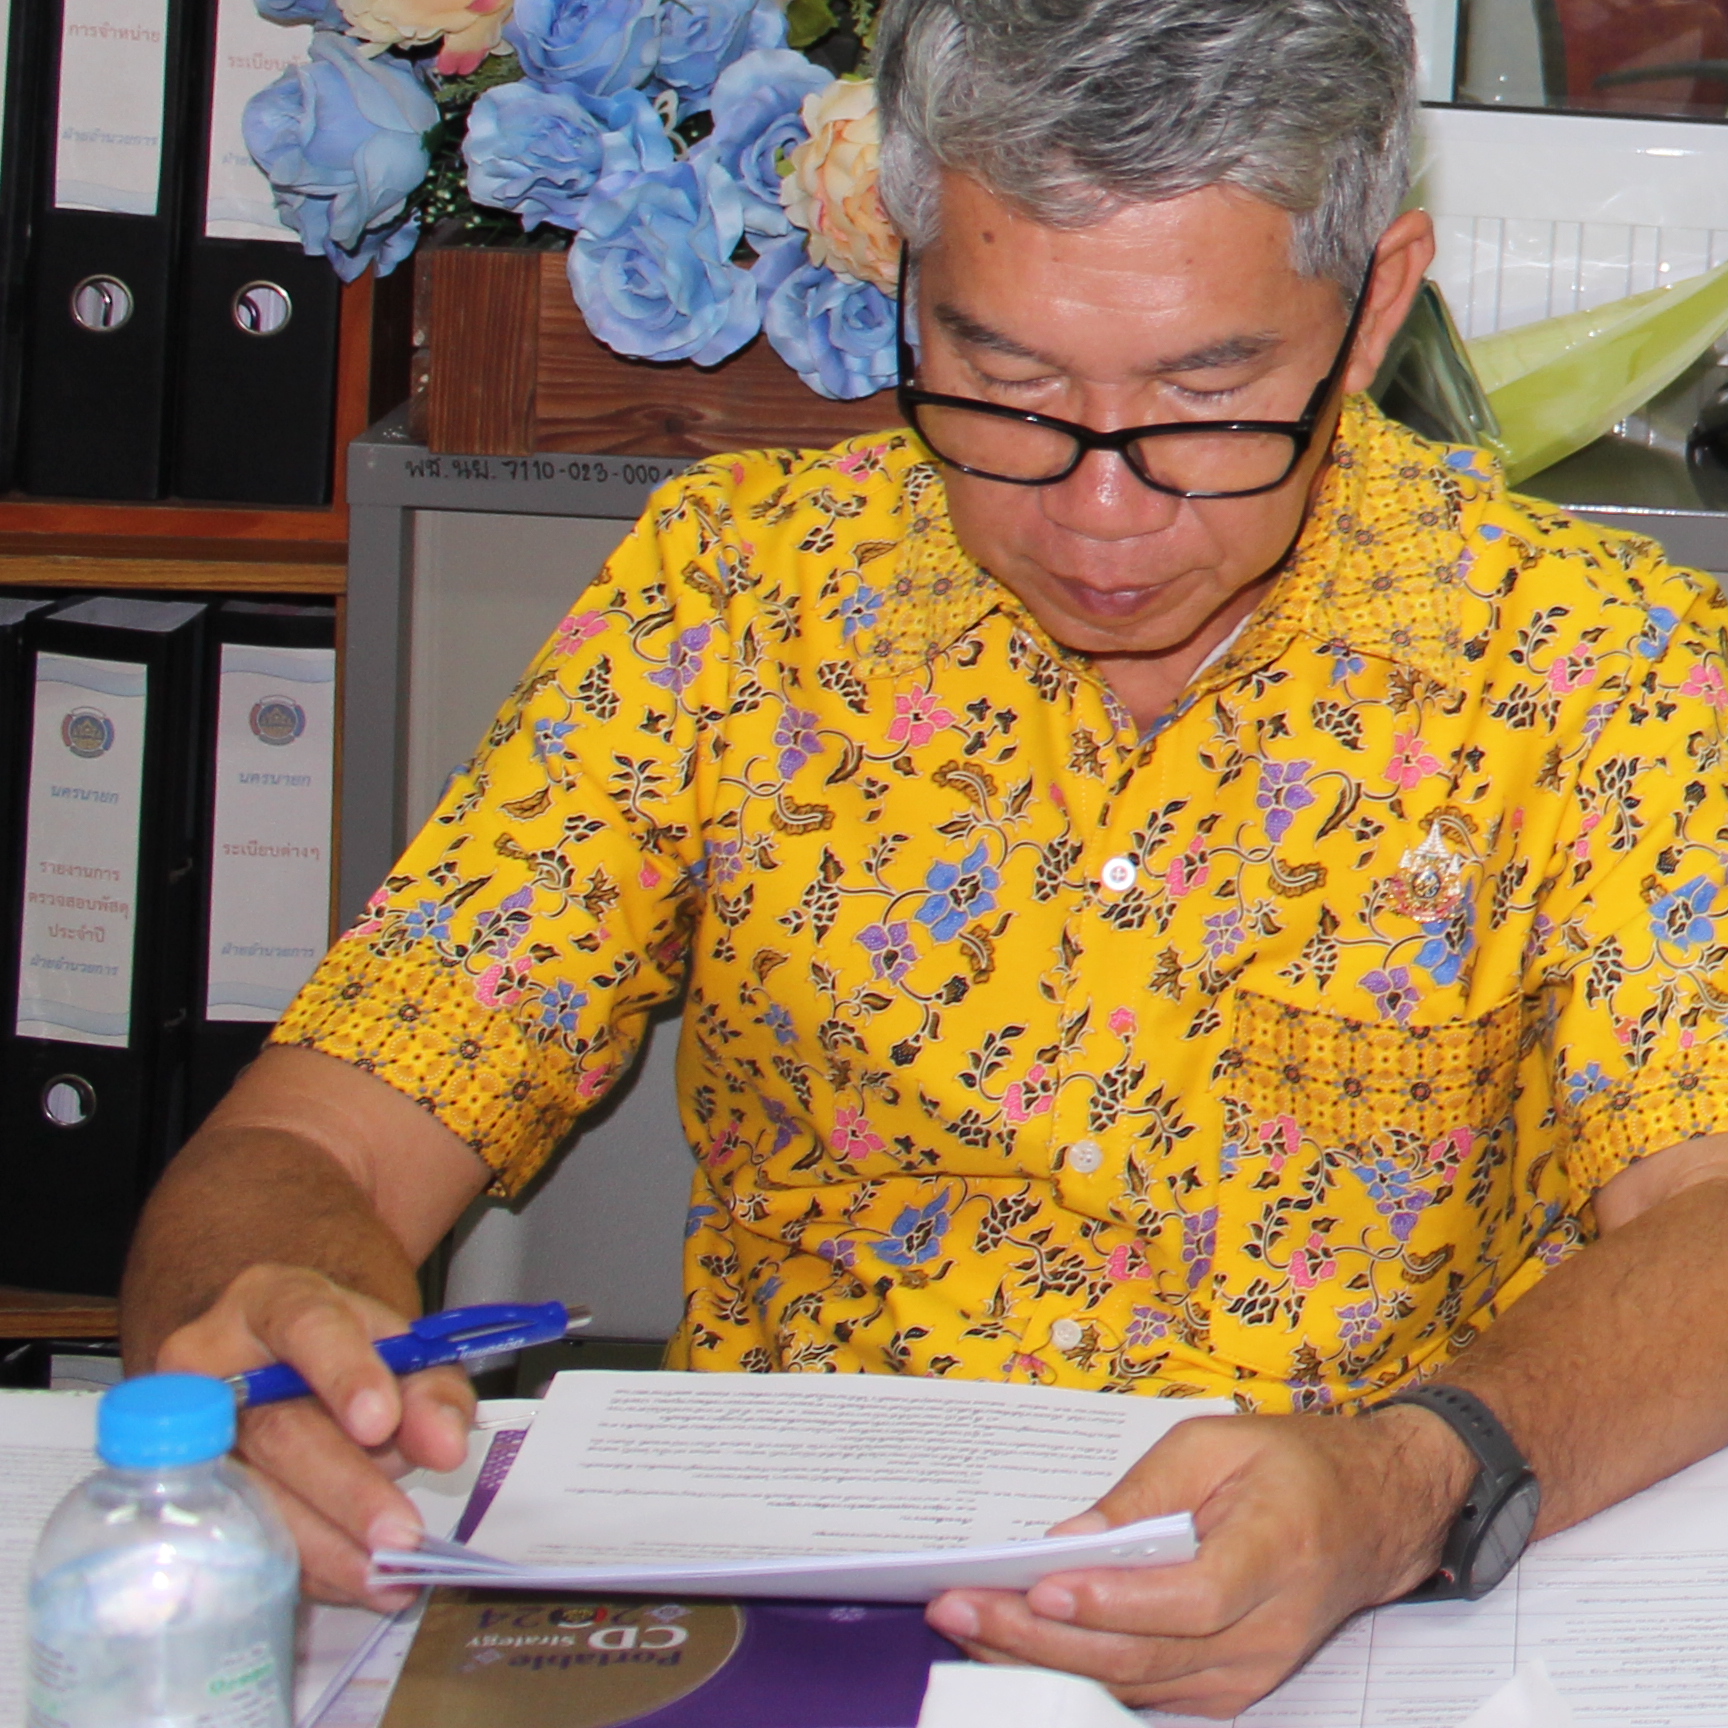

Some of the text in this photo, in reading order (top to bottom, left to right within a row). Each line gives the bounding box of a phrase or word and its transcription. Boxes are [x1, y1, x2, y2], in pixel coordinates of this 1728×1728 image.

[68, 20, 161, 45] การจำหน่าย
[238, 770, 312, 788] นครนายก
[50, 783, 120, 805] นครนายก
[221, 839, 320, 861] ระเบียบต่างๆ
[38, 859, 121, 882] รายงานการ
[27, 889, 129, 920] ตรวจสอบพัสดุ
[47, 922, 106, 943] ประจำปี
[464, 1624, 690, 1651] CD Strategy
[506, 1650, 682, 1672] Portable
